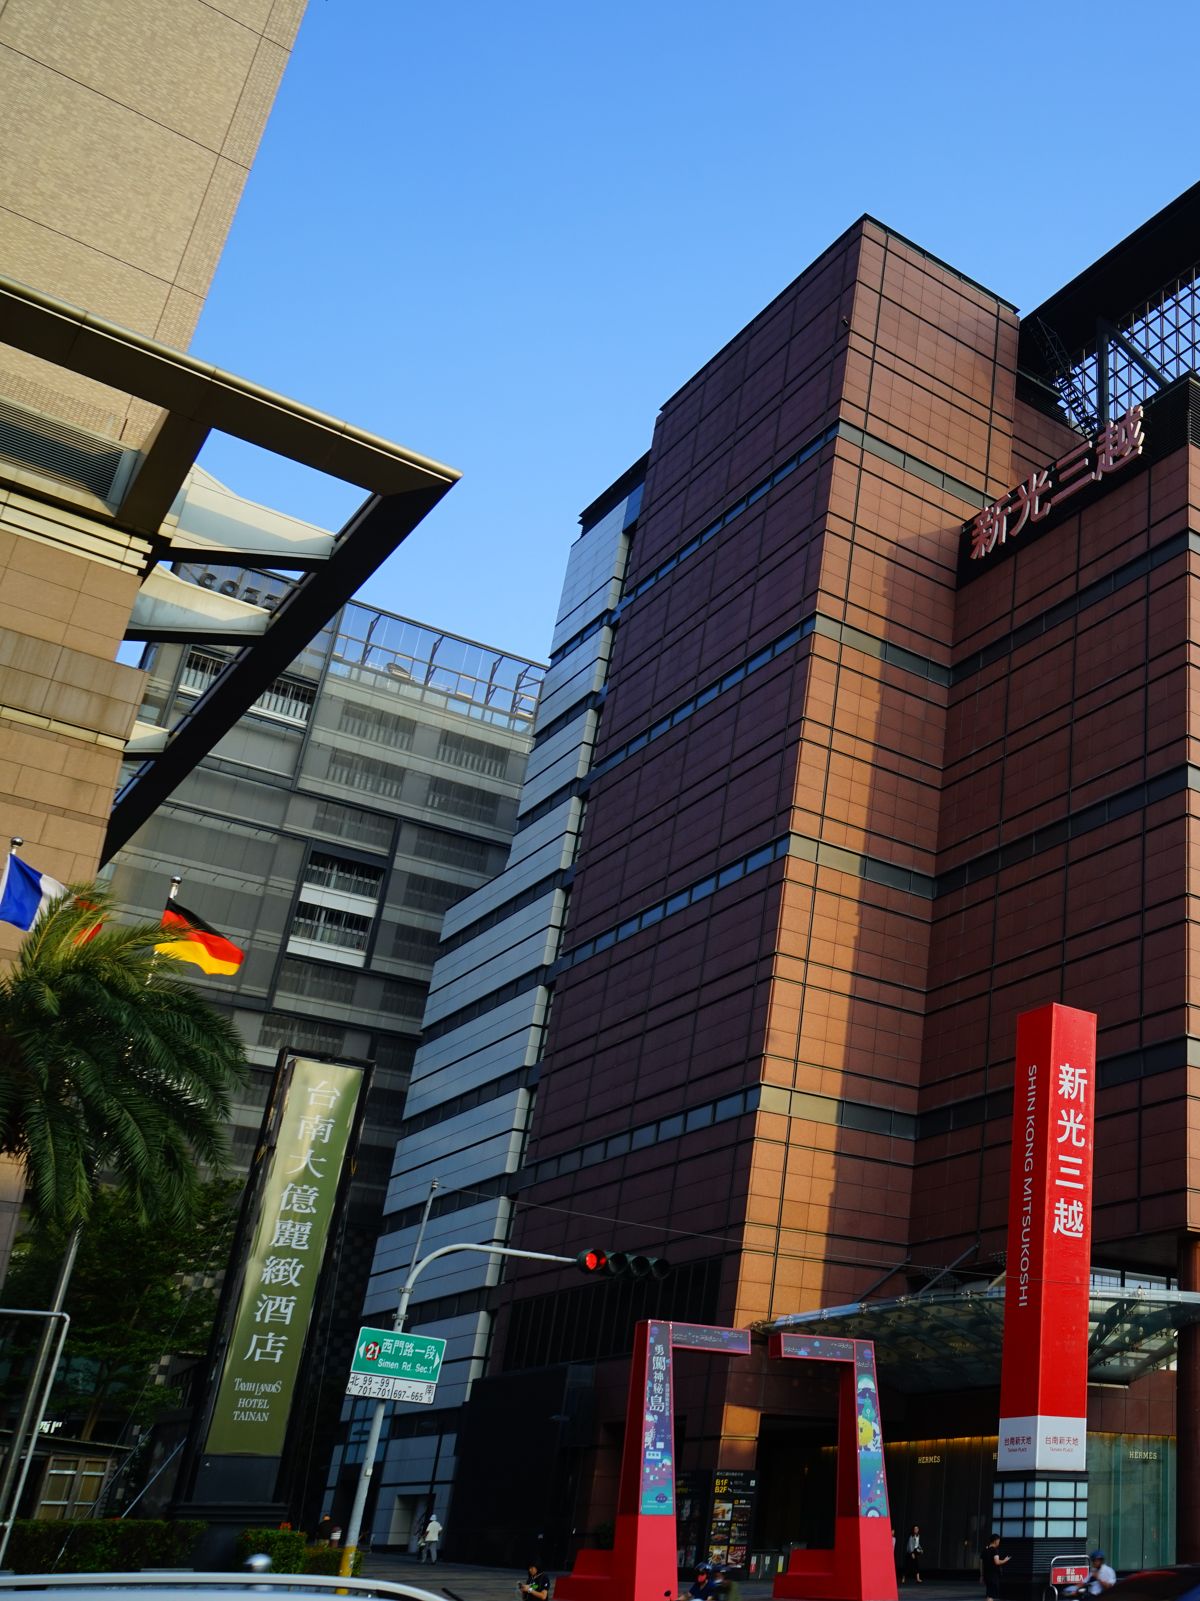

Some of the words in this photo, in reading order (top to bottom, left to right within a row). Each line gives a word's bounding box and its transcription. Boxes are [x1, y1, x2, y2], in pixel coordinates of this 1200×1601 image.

[970, 405, 1145, 560] 新光三越
[1027, 1064, 1037, 1111] SHIN
[1024, 1116, 1035, 1171] KONG
[1052, 1063, 1088, 1238] 新光三越
[243, 1080, 341, 1363] 台南大億麗緻酒店
[1018, 1177, 1033, 1307] MITSUKOSHI
[366, 1343, 380, 1359] 21
[381, 1338, 437, 1360] 西門路一段
[377, 1358, 399, 1370] Simen
[350, 1375, 360, 1387] 北
[237, 1398, 270, 1409] HOTEL
[232, 1411, 270, 1422] TAINAN
[1045, 1435, 1079, 1447] 台南新天地
